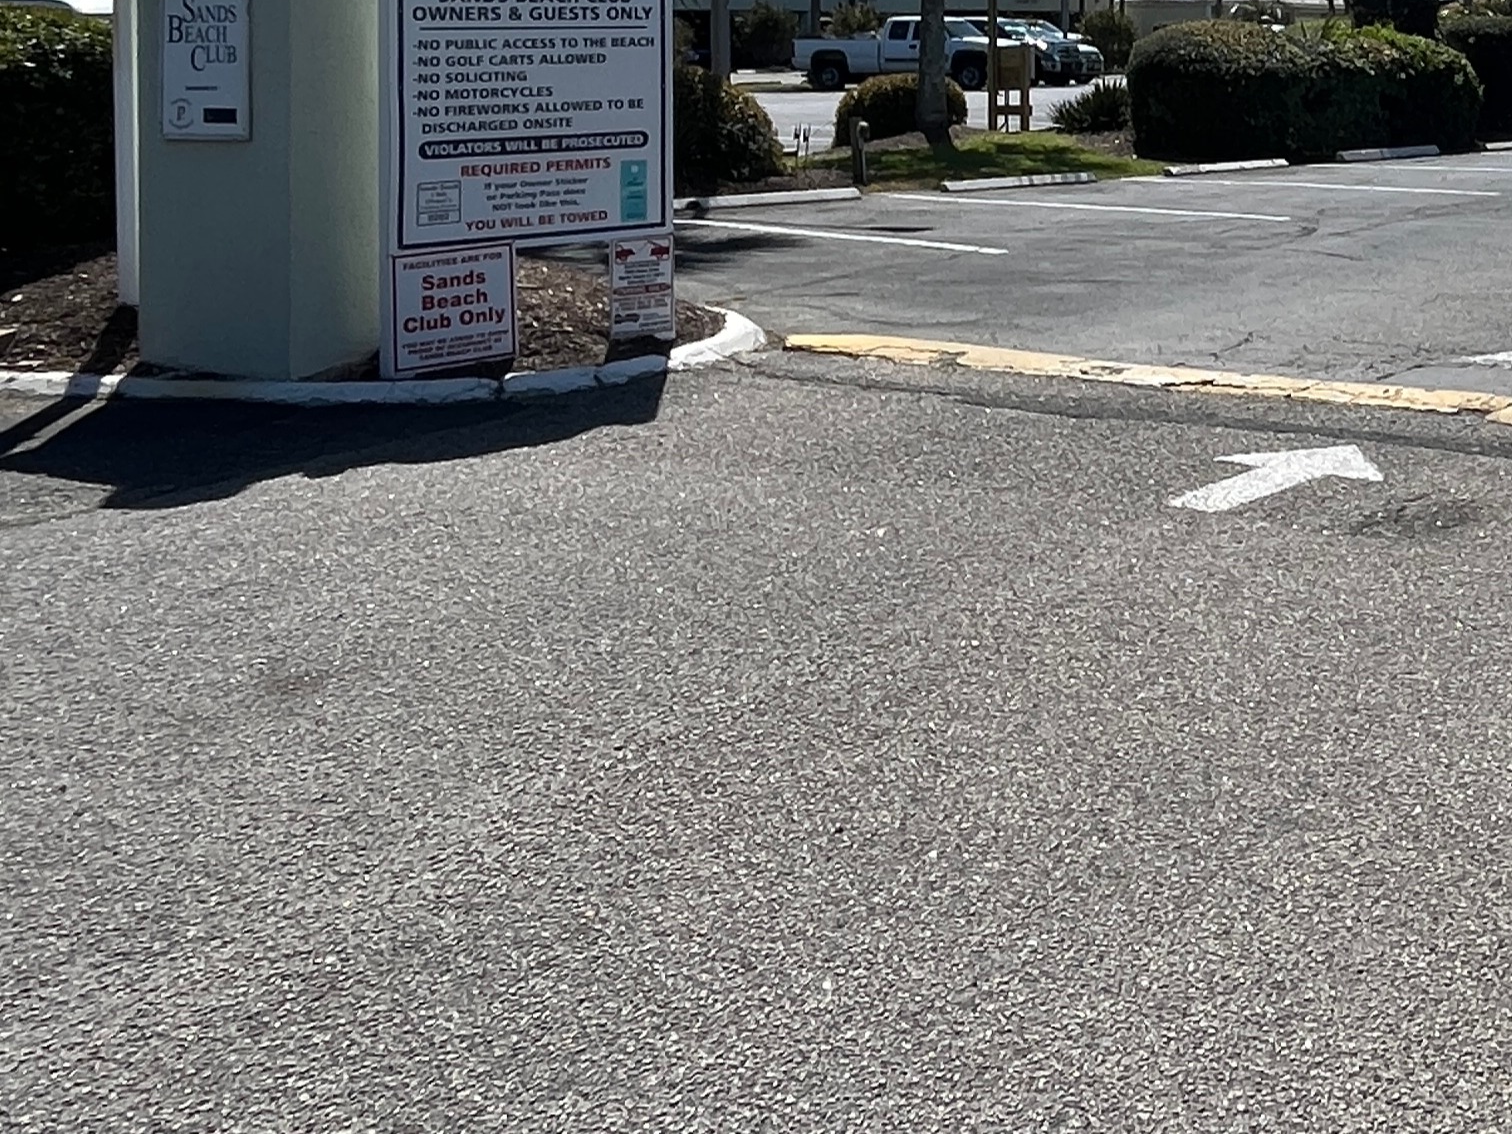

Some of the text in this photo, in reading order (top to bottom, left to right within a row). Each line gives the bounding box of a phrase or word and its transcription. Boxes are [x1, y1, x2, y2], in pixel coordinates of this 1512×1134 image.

[412, 6, 653, 22] OWNERS & GUESTS ONLY
[167, 15, 227, 44] BEACH
[445, 39, 498, 51] PUBLIC
[502, 38, 556, 50] ACCESS
[560, 37, 578, 49] TO
[583, 37, 607, 48] THE
[610, 36, 655, 48] BEACH
[191, 45, 238, 72] CLUB
[445, 55, 484, 67] GOLF
[488, 54, 534, 66] CARTS
[539, 53, 607, 65] ALLOWED
[445, 71, 528, 83] SOLICITING
[445, 86, 553, 101] MOTORCYCLES
[445, 103, 530, 116] FIREWORKS
[534, 100, 603, 114] ALLOWED
[607, 99, 624, 111] TO
[628, 98, 644, 110] BE
[421, 117, 573, 135] DISCHARGED ONSITE
[424, 134, 644, 156] VIOLATORS WILL BE PROSECUTED
[460, 157, 611, 177] REQUIRED PERMITS
[492, 203, 511, 212] NOT
[465, 210, 608, 232] YOU WILL BE TOWED
[421, 269, 486, 291] Sands
[422, 288, 488, 311] Beach
[403, 306, 505, 334] Club Only
